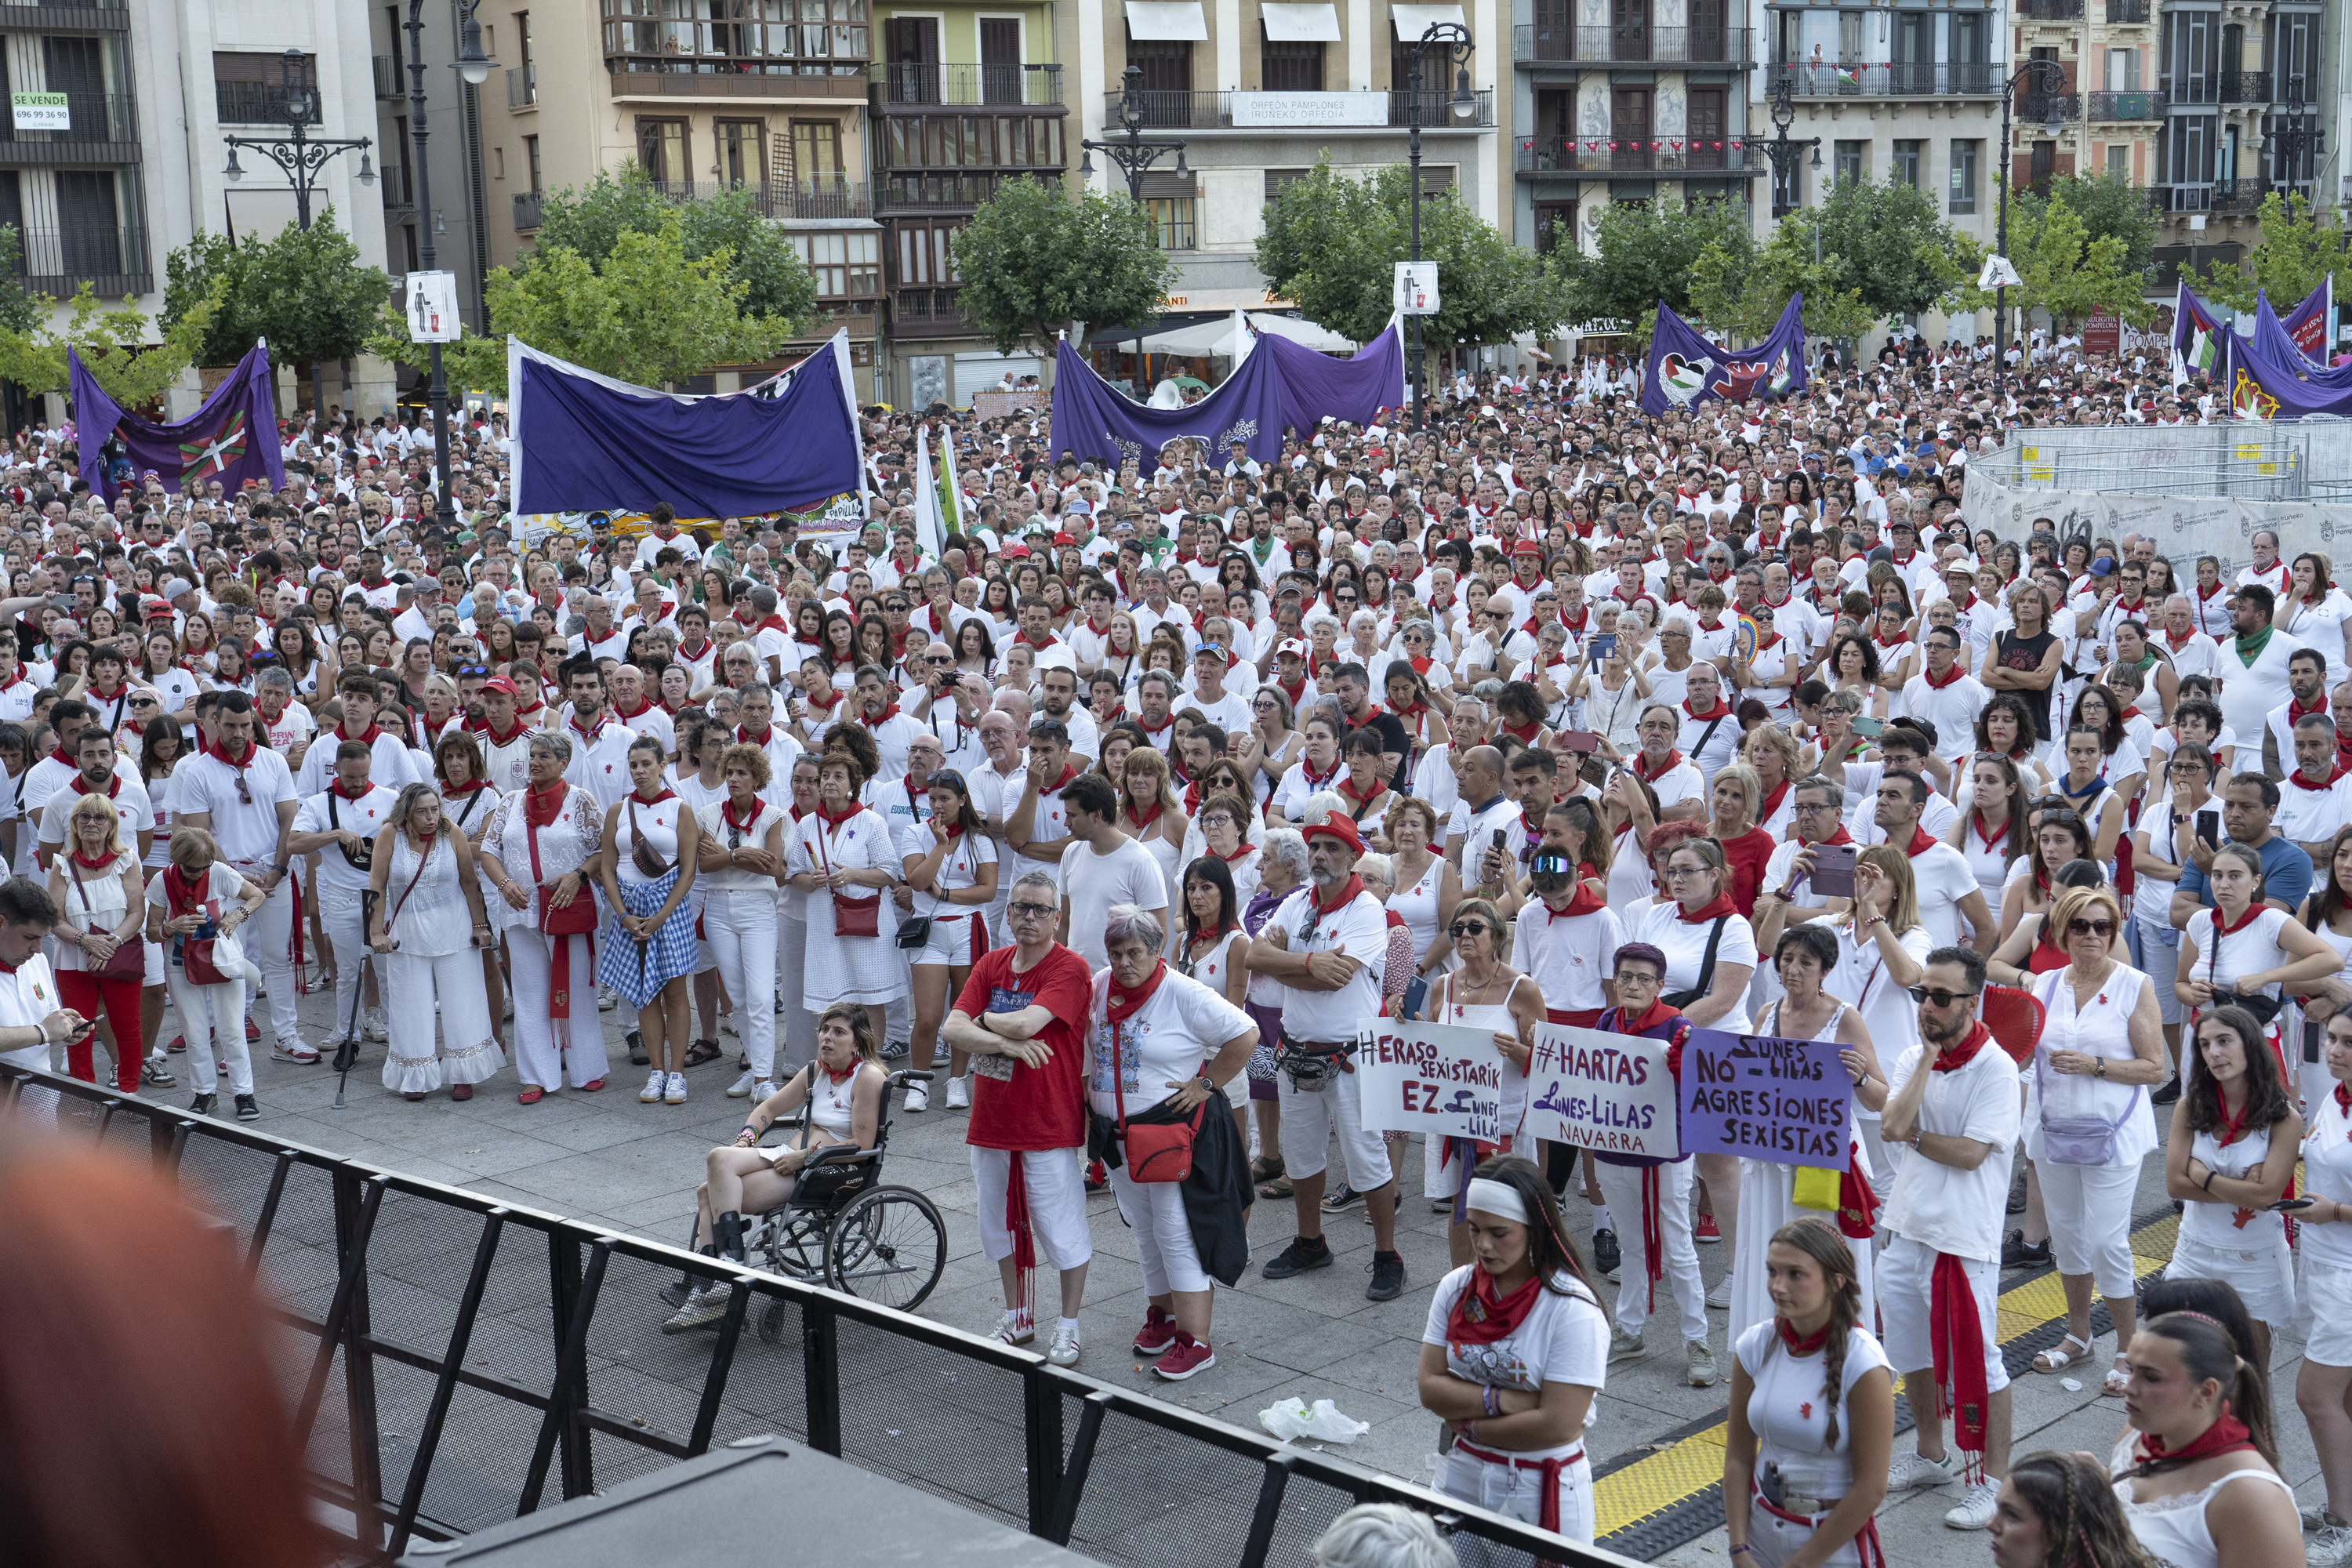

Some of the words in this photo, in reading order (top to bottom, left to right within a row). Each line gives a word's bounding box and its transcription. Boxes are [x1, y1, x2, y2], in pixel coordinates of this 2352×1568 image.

[15, 96, 27, 104] SE
[30, 96, 66, 105] VENDE
[1251, 100, 1287, 109] ORFEÓN
[1291, 100, 1345, 109] PAMPLONÉS
[1251, 110, 1296, 118] IRUÑEKO
[2280, 513, 2304, 521] Iruñeko
[1697, 1049, 1735, 1083] NO
[1560, 1121, 1645, 1153] NAVARRA
